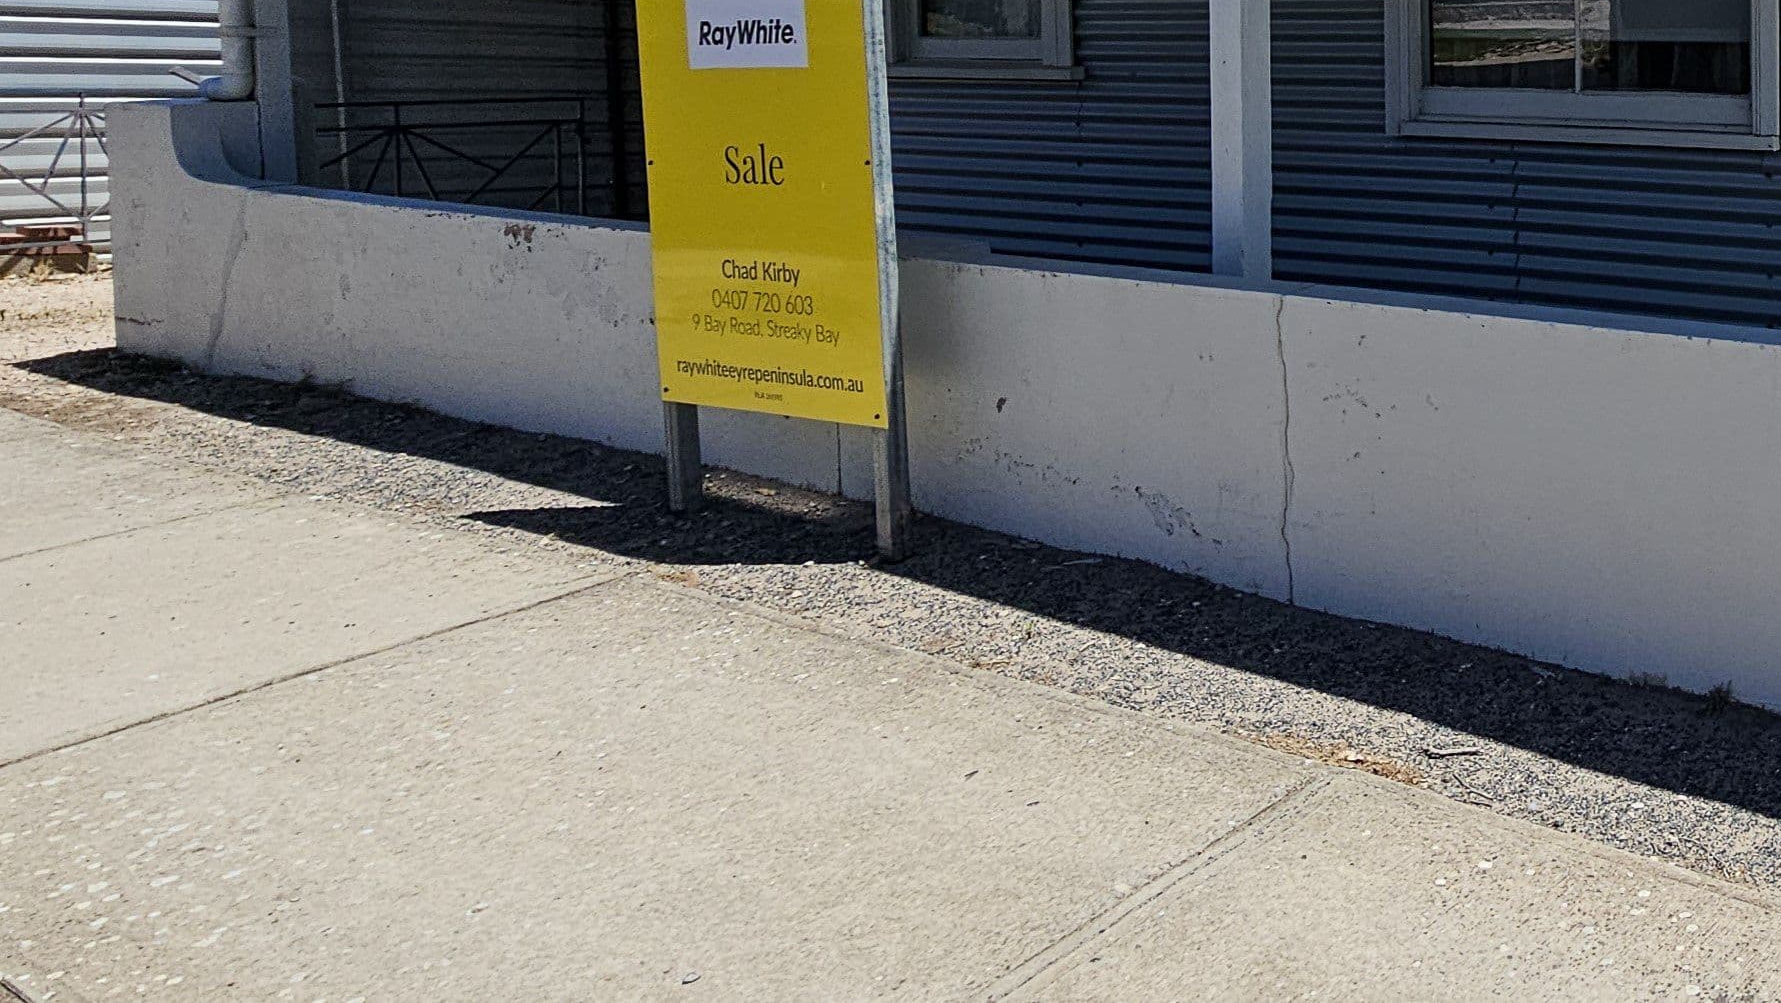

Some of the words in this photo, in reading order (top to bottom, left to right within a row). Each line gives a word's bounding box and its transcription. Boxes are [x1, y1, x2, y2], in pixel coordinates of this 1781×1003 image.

[724, 143, 785, 186] Sale
[721, 259, 758, 280] Chad
[762, 262, 800, 288] Kirby
[711, 289, 749, 311] 0407
[753, 292, 780, 314] 720
[785, 293, 814, 316] 603
[692, 314, 700, 328] 9
[704, 314, 726, 335] Bay
[767, 320, 812, 343] Streaky
[816, 325, 840, 347] Bay
[677, 358, 864, 393] raywhiteeyrepeninsula.com.au
